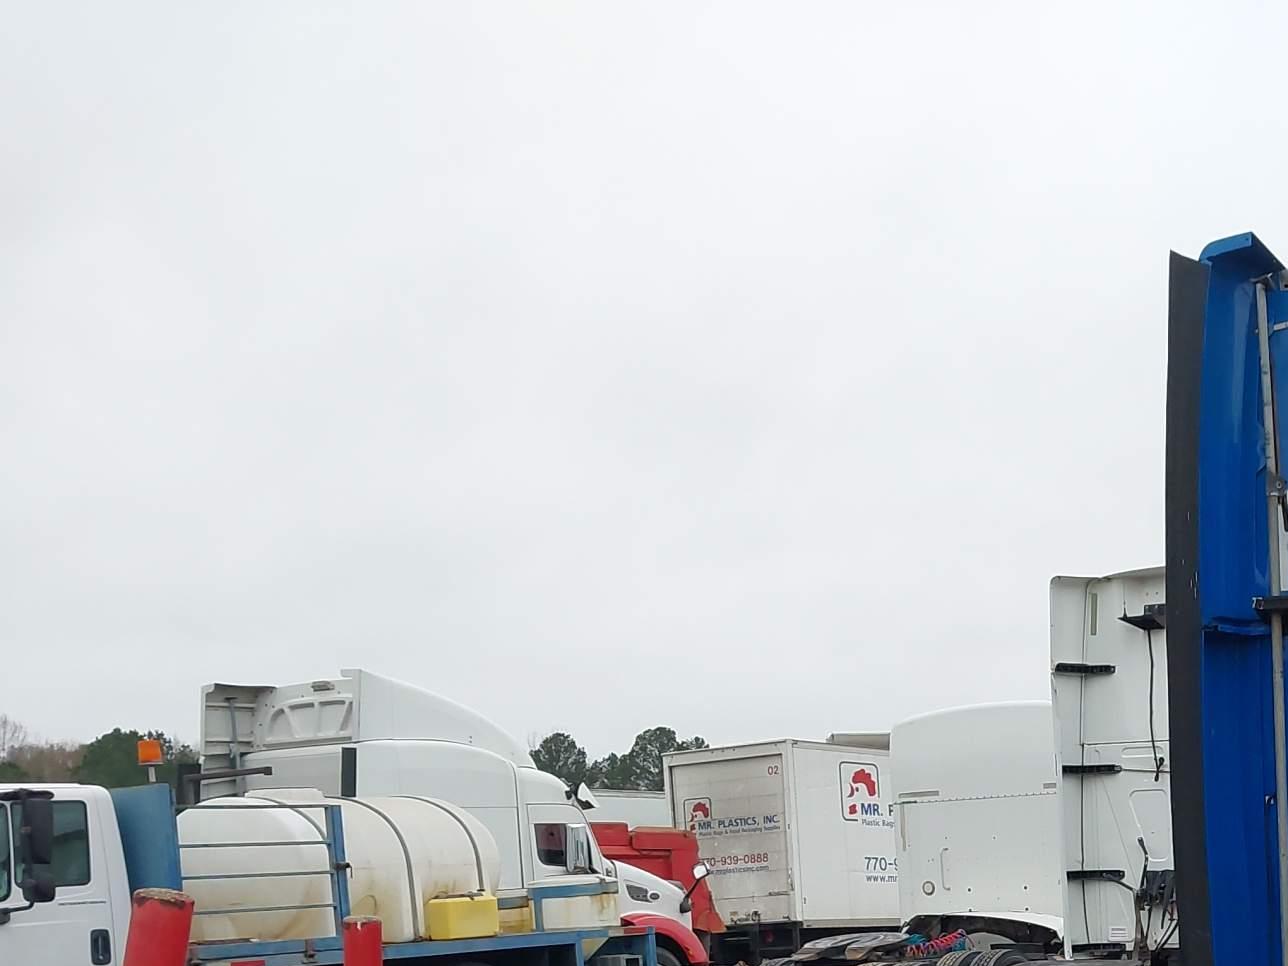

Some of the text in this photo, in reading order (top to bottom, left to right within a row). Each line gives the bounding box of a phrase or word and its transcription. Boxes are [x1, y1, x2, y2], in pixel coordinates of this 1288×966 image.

[767, 765, 779, 776] 02
[860, 802, 884, 816] MR.
[697, 820, 714, 831] MR.
[717, 816, 760, 830] PLASTICS,
[882, 819, 895, 829] Bag
